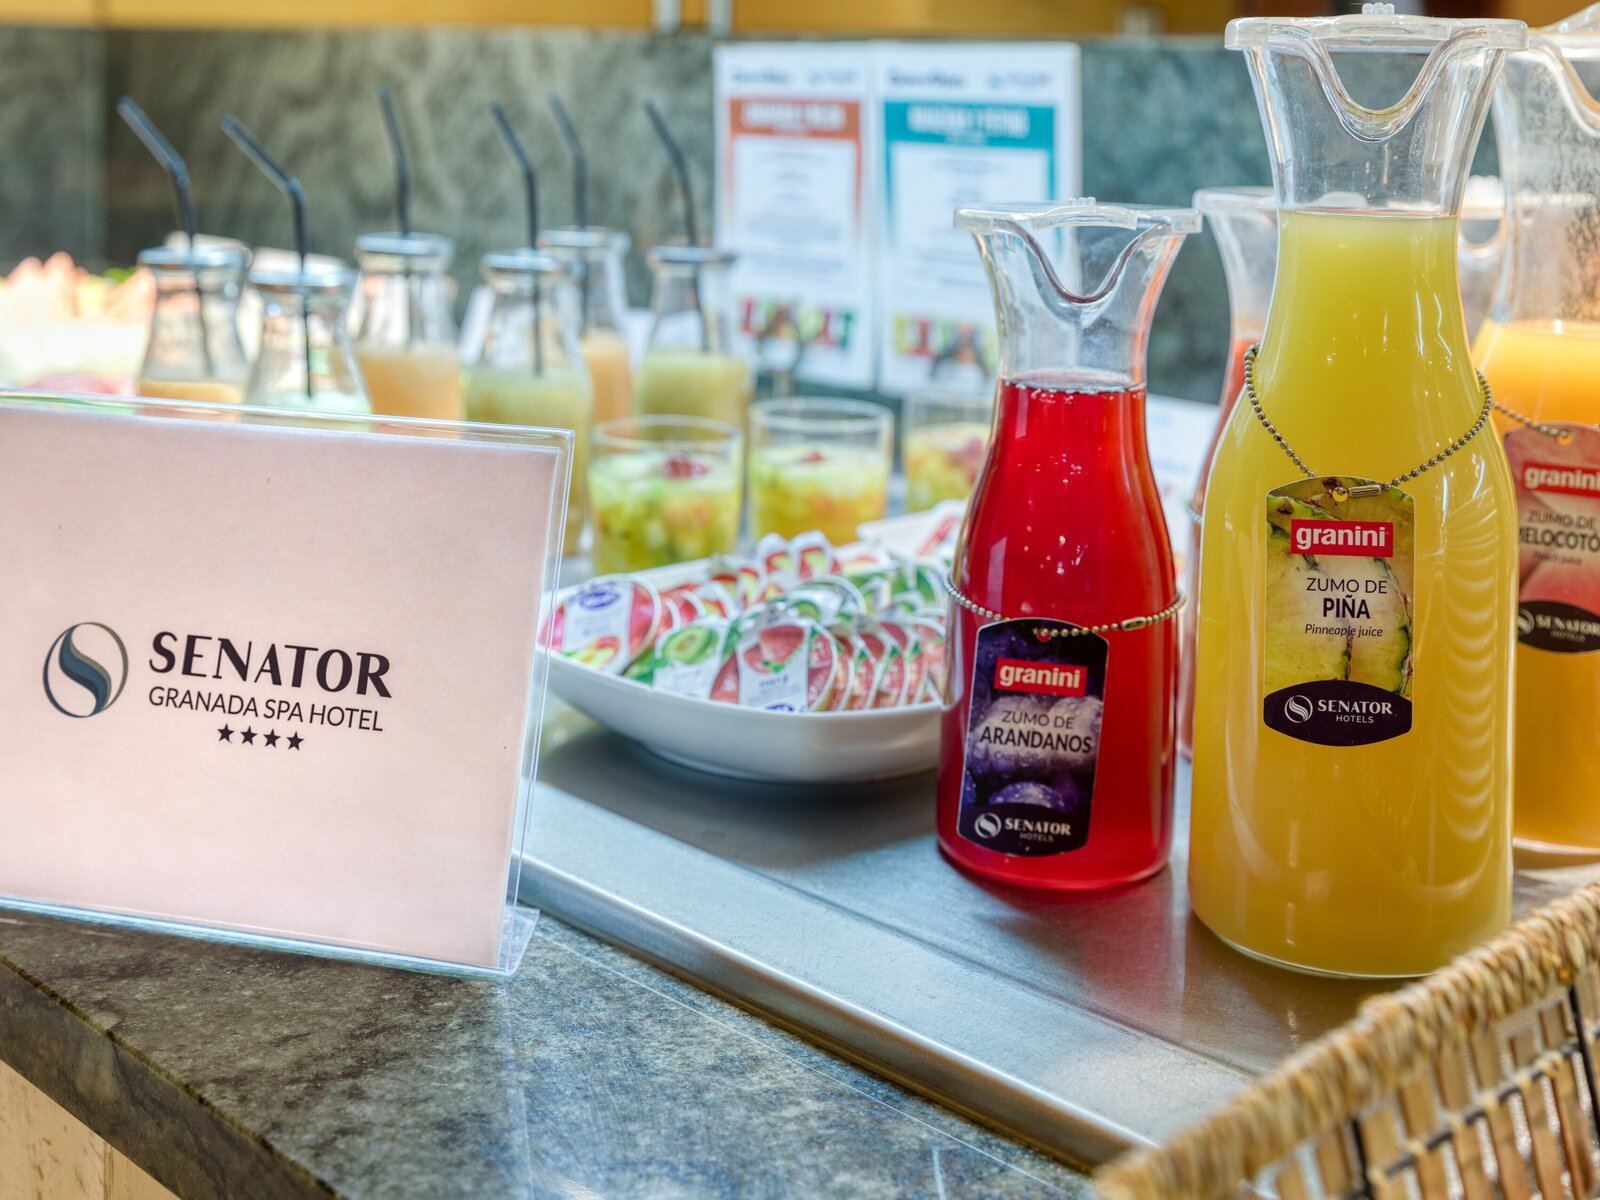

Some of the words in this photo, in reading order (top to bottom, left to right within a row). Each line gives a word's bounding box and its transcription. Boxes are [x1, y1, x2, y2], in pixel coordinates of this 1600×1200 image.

[1527, 509, 1574, 527] ZUMO
[1296, 525, 1386, 550] granini
[1306, 577, 1360, 593] ZUMO
[1365, 579, 1388, 594] DE
[1323, 594, 1371, 619] PIÑA
[1305, 623, 1356, 637] Pinneaple
[1357, 625, 1384, 638] juice
[1536, 614, 1600, 636] SENATOR
[149, 631, 392, 698] SENATOR
[1000, 665, 1081, 689] granini
[149, 686, 259, 718] GRANADA
[263, 699, 304, 723] SPA
[309, 703, 383, 731] HOTEL
[1317, 699, 1393, 715] SENATOR
[1002, 710, 1050, 727] ZUMO
[1054, 716, 1075, 729] DE
[1336, 715, 1374, 724] HOTELS
[979, 726, 1092, 754] ARANDANOS
[1004, 817, 1071, 836] SENATOR
[1019, 832, 1054, 843] HOTELS
